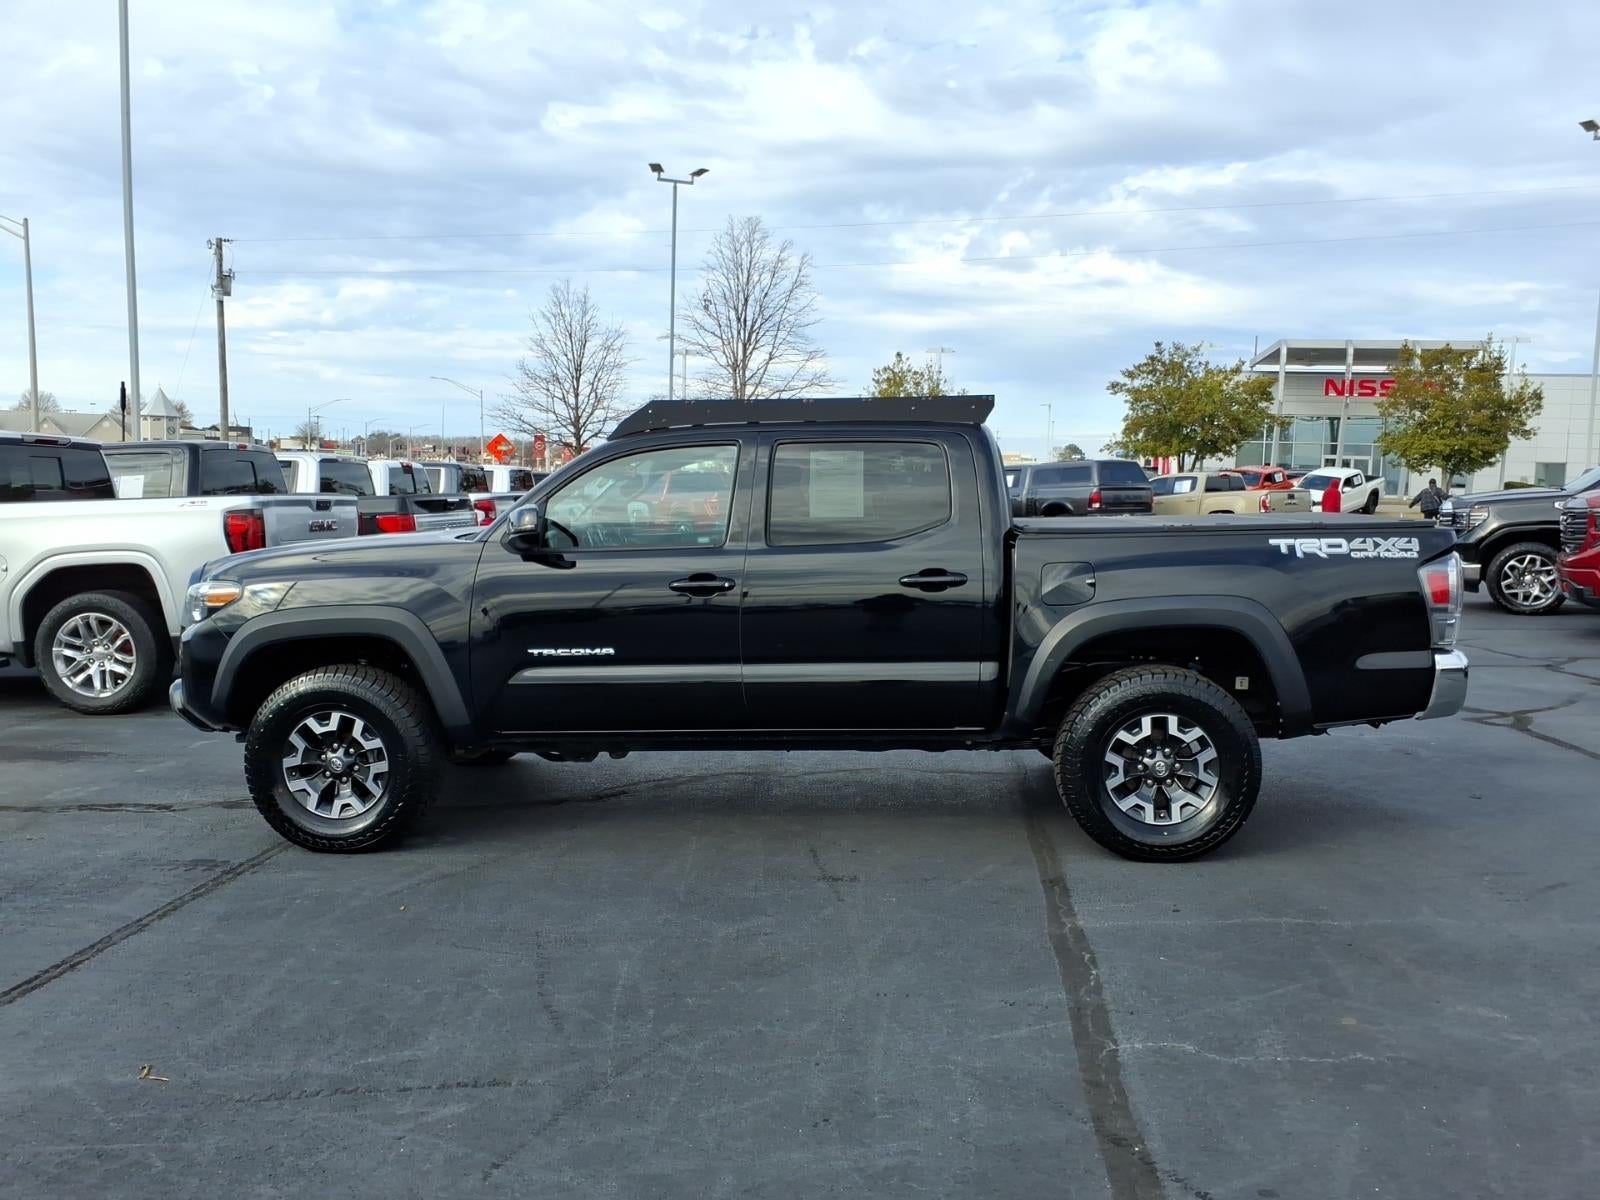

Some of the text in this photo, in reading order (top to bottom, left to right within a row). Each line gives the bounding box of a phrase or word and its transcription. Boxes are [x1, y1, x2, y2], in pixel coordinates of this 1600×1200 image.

[1324, 378, 1446, 397] NISS
[1268, 538, 1350, 559] TRD
[1350, 551, 1419, 559] OFF ROAD
[527, 648, 615, 657] TACOMA
